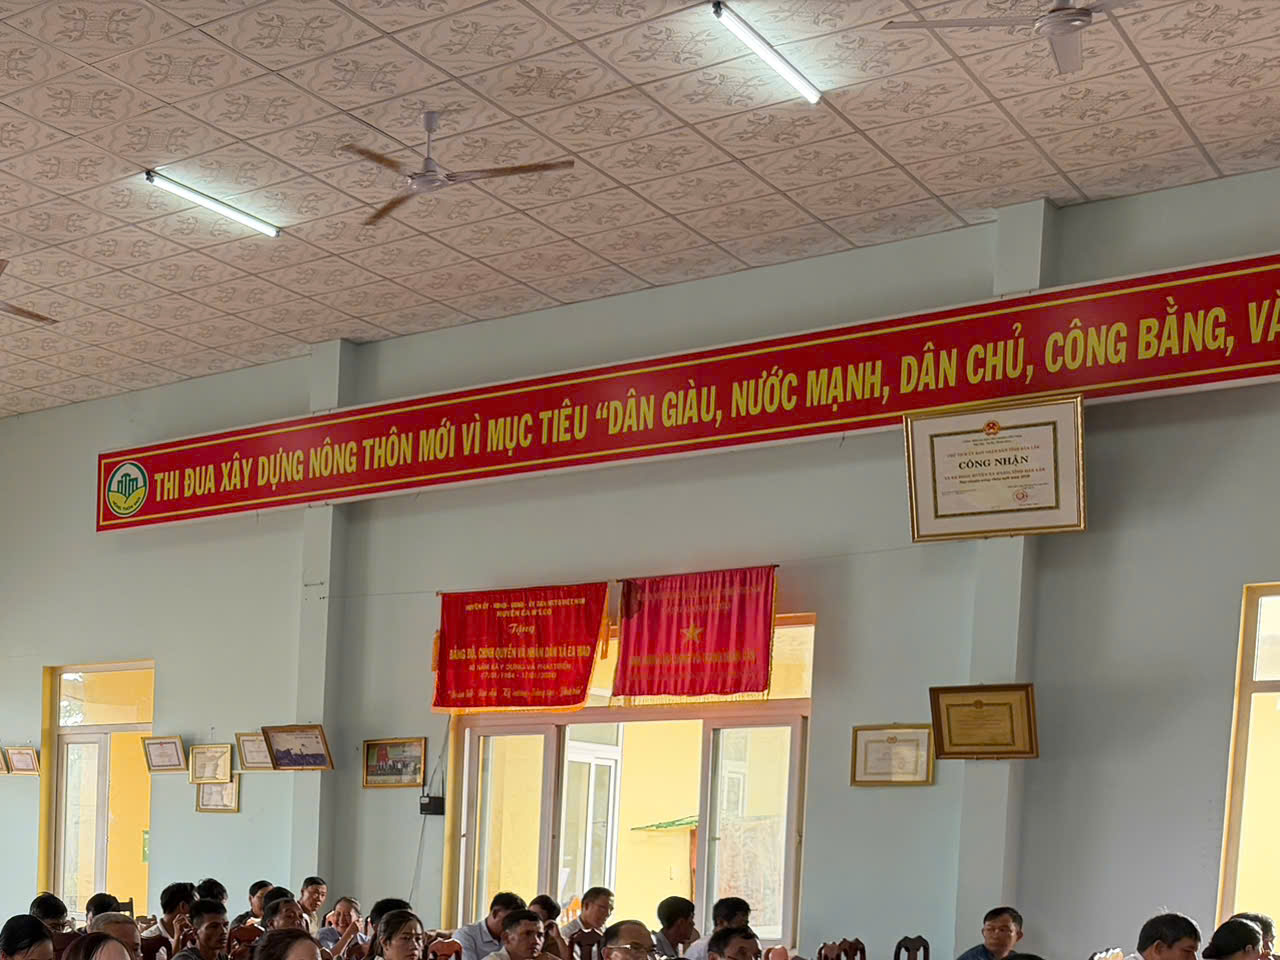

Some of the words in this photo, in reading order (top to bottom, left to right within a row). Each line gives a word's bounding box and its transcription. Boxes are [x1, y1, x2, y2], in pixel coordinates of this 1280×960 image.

[153, 470, 180, 502] THI
[183, 464, 216, 498] ĐUA
[219, 451, 254, 492] XÂY
[257, 446, 305, 491] DỰNG
[308, 436, 358, 479] NÔNG
[362, 426, 413, 471] THÔN
[418, 418, 456, 463] MỚI
[461, 413, 481, 456] VÌ
[487, 413, 534, 457] MỤC
[538, 398, 588, 445] TIÊU
[661, 379, 723, 428] GIÀU,
[730, 365, 798, 418] NƯỚC
[805, 359, 890, 412] MẠNH,
[899, 341, 958, 394] DÂN
[966, 322, 1034, 385] CHỦ,
[1044, 317, 1128, 373] CÔNG
[1137, 296, 1235, 360] BẰNG,
[958, 456, 991, 471] CÔNG
[994, 455, 1029, 468] NHẬN
